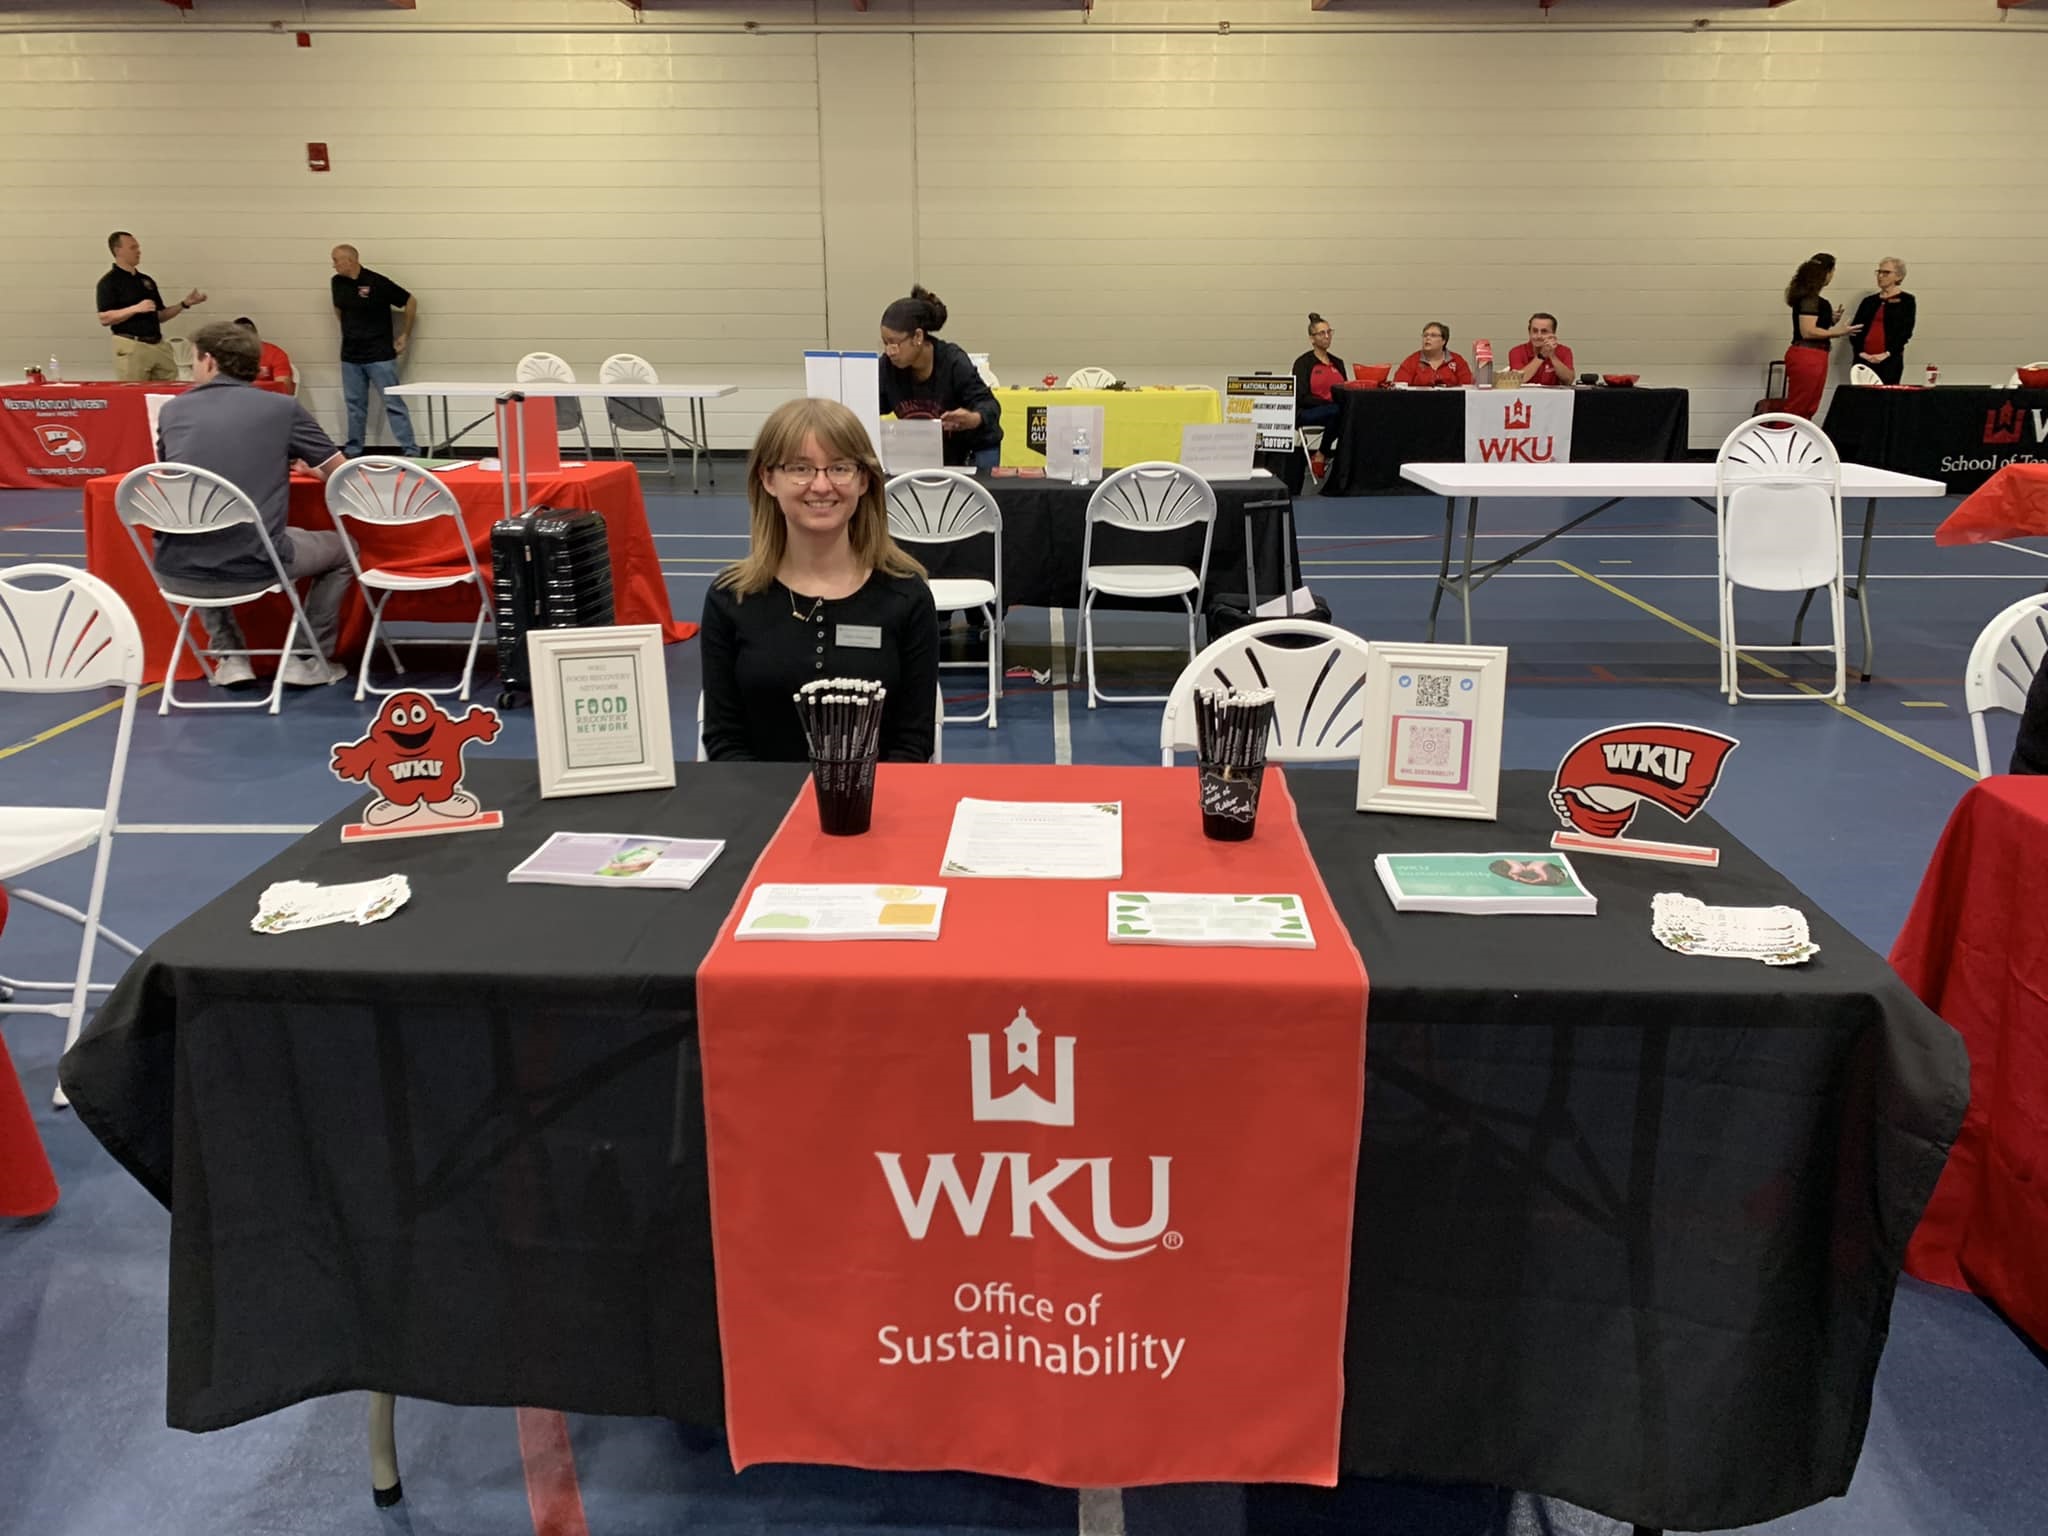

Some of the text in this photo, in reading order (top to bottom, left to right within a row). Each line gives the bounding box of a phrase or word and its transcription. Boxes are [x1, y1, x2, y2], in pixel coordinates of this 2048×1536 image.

[1479, 436, 1553, 463] WKU
[1941, 455, 1997, 472] School
[575, 696, 628, 716] FOOD
[577, 722, 628, 733] NETWORK
[388, 760, 444, 780] WKU
[1602, 744, 1693, 784] WKU
[874, 1152, 1173, 1261] WKU
[954, 1281, 1102, 1326] Office of
[878, 1324, 1185, 1379] Sustainability
